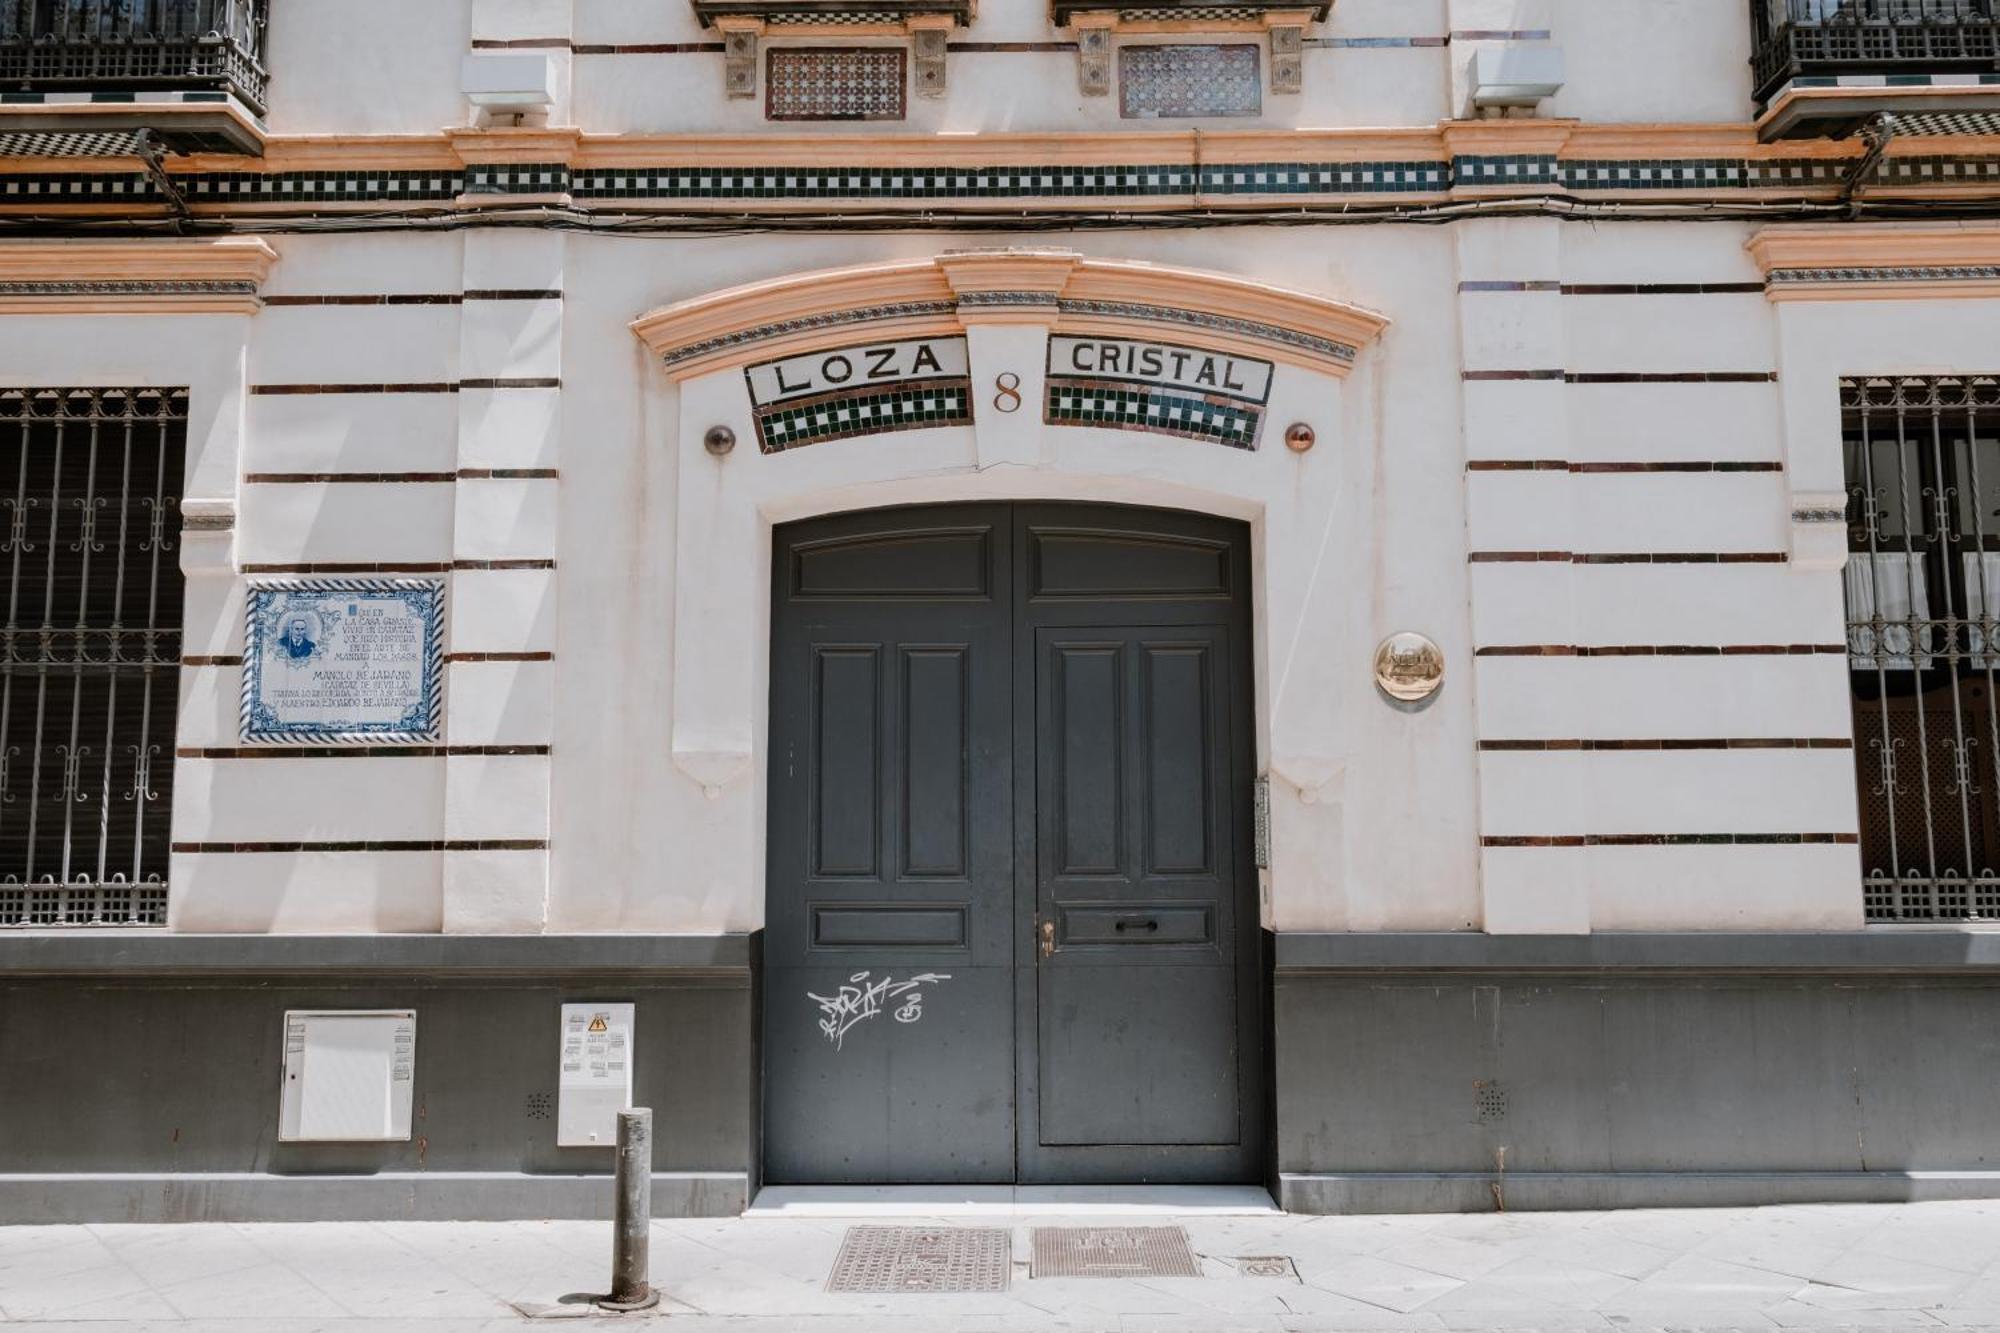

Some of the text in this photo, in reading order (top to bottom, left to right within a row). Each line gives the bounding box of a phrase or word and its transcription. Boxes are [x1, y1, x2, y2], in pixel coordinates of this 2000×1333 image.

[774, 344, 944, 395] LOZA
[993, 371, 1022, 413] 8
[1071, 342, 1244, 392] CRISTAL
